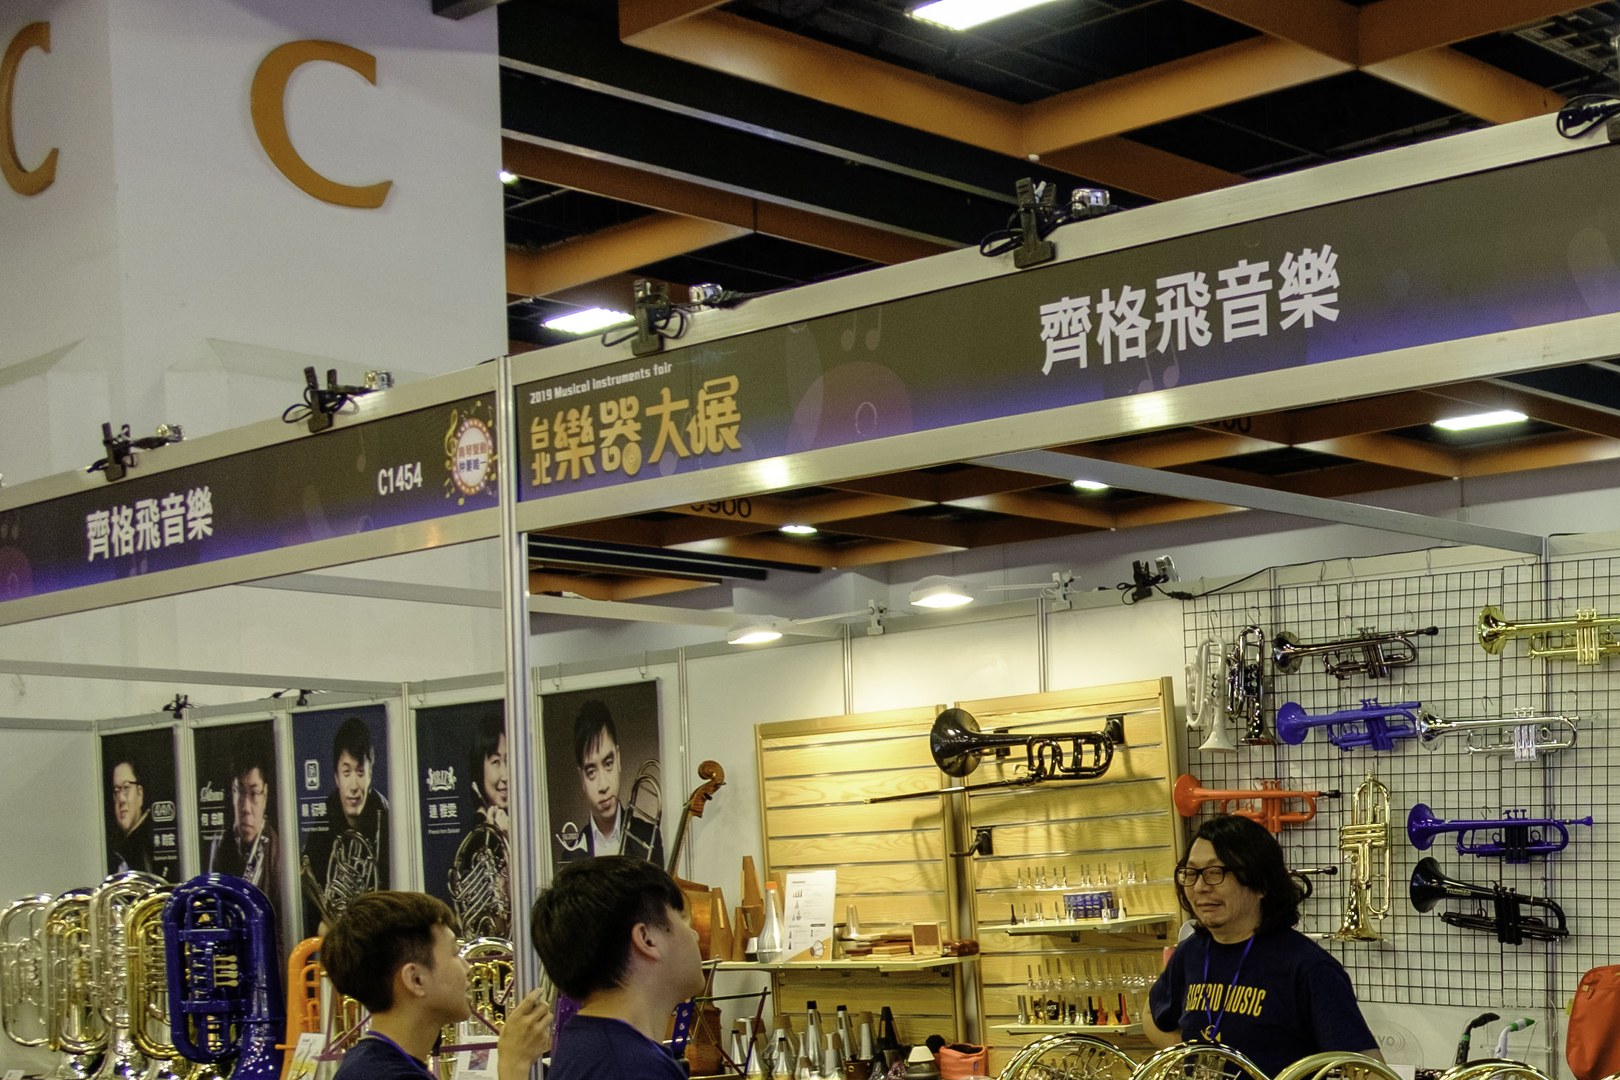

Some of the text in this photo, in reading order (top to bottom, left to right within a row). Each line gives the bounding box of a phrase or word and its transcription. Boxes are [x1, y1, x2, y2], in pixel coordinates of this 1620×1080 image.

[250, 40, 394, 210] C
[1039, 244, 1342, 376] 齊格飛音樂
[529, 362, 673, 405] 2019 Musical instruments fair
[378, 461, 423, 496] C1454
[85, 485, 214, 562] 齊格飛音樂
[1224, 984, 1266, 1017] MUSIC
